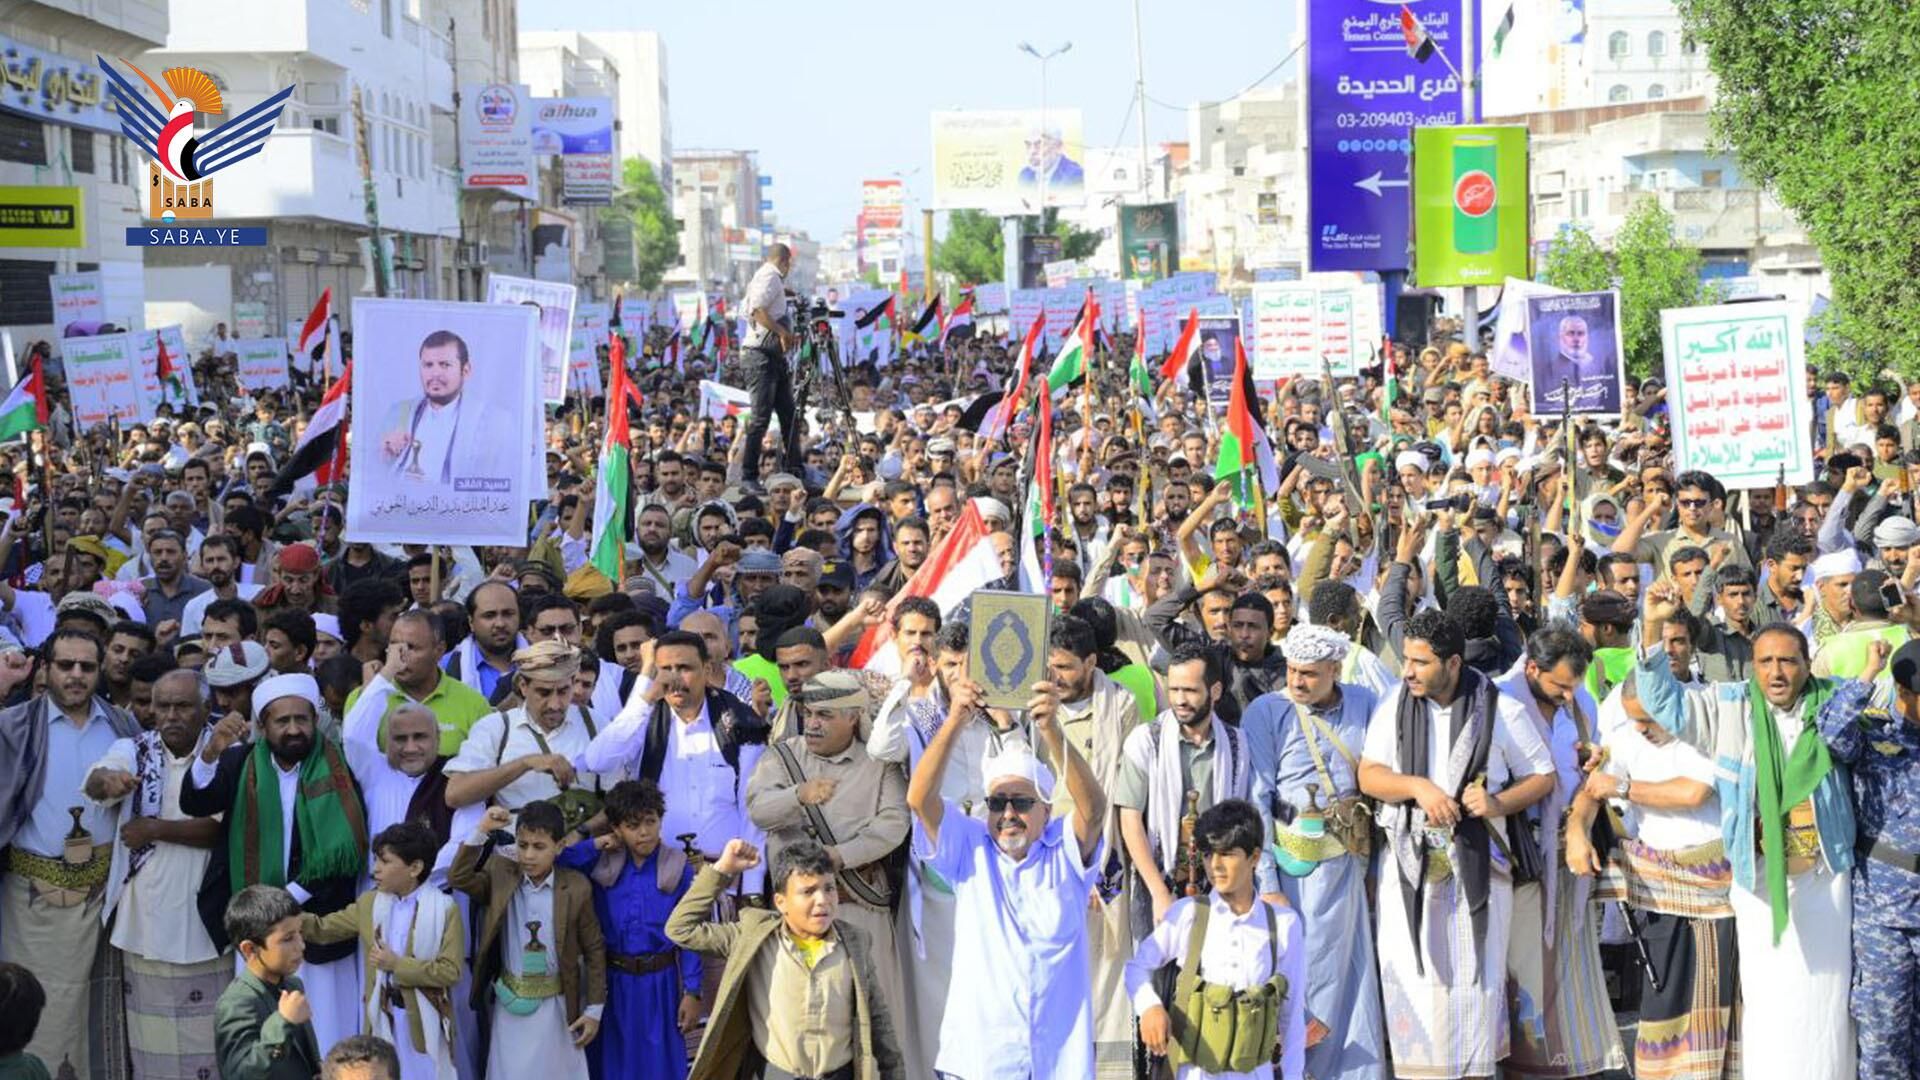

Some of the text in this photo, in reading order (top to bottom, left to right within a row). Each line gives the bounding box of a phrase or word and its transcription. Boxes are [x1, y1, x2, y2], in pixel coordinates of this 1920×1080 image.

[1337, 74, 1458, 101] فرع الحديدة
[1336, 111, 1414, 128] 03-209403
[1745, 324, 1783, 350] الله
[1741, 359, 1785, 381] الموت
[1744, 386, 1788, 408] الموت
[1688, 413, 1791, 440] اللعنة على اليهود
[1748, 436, 1792, 468] النصر
